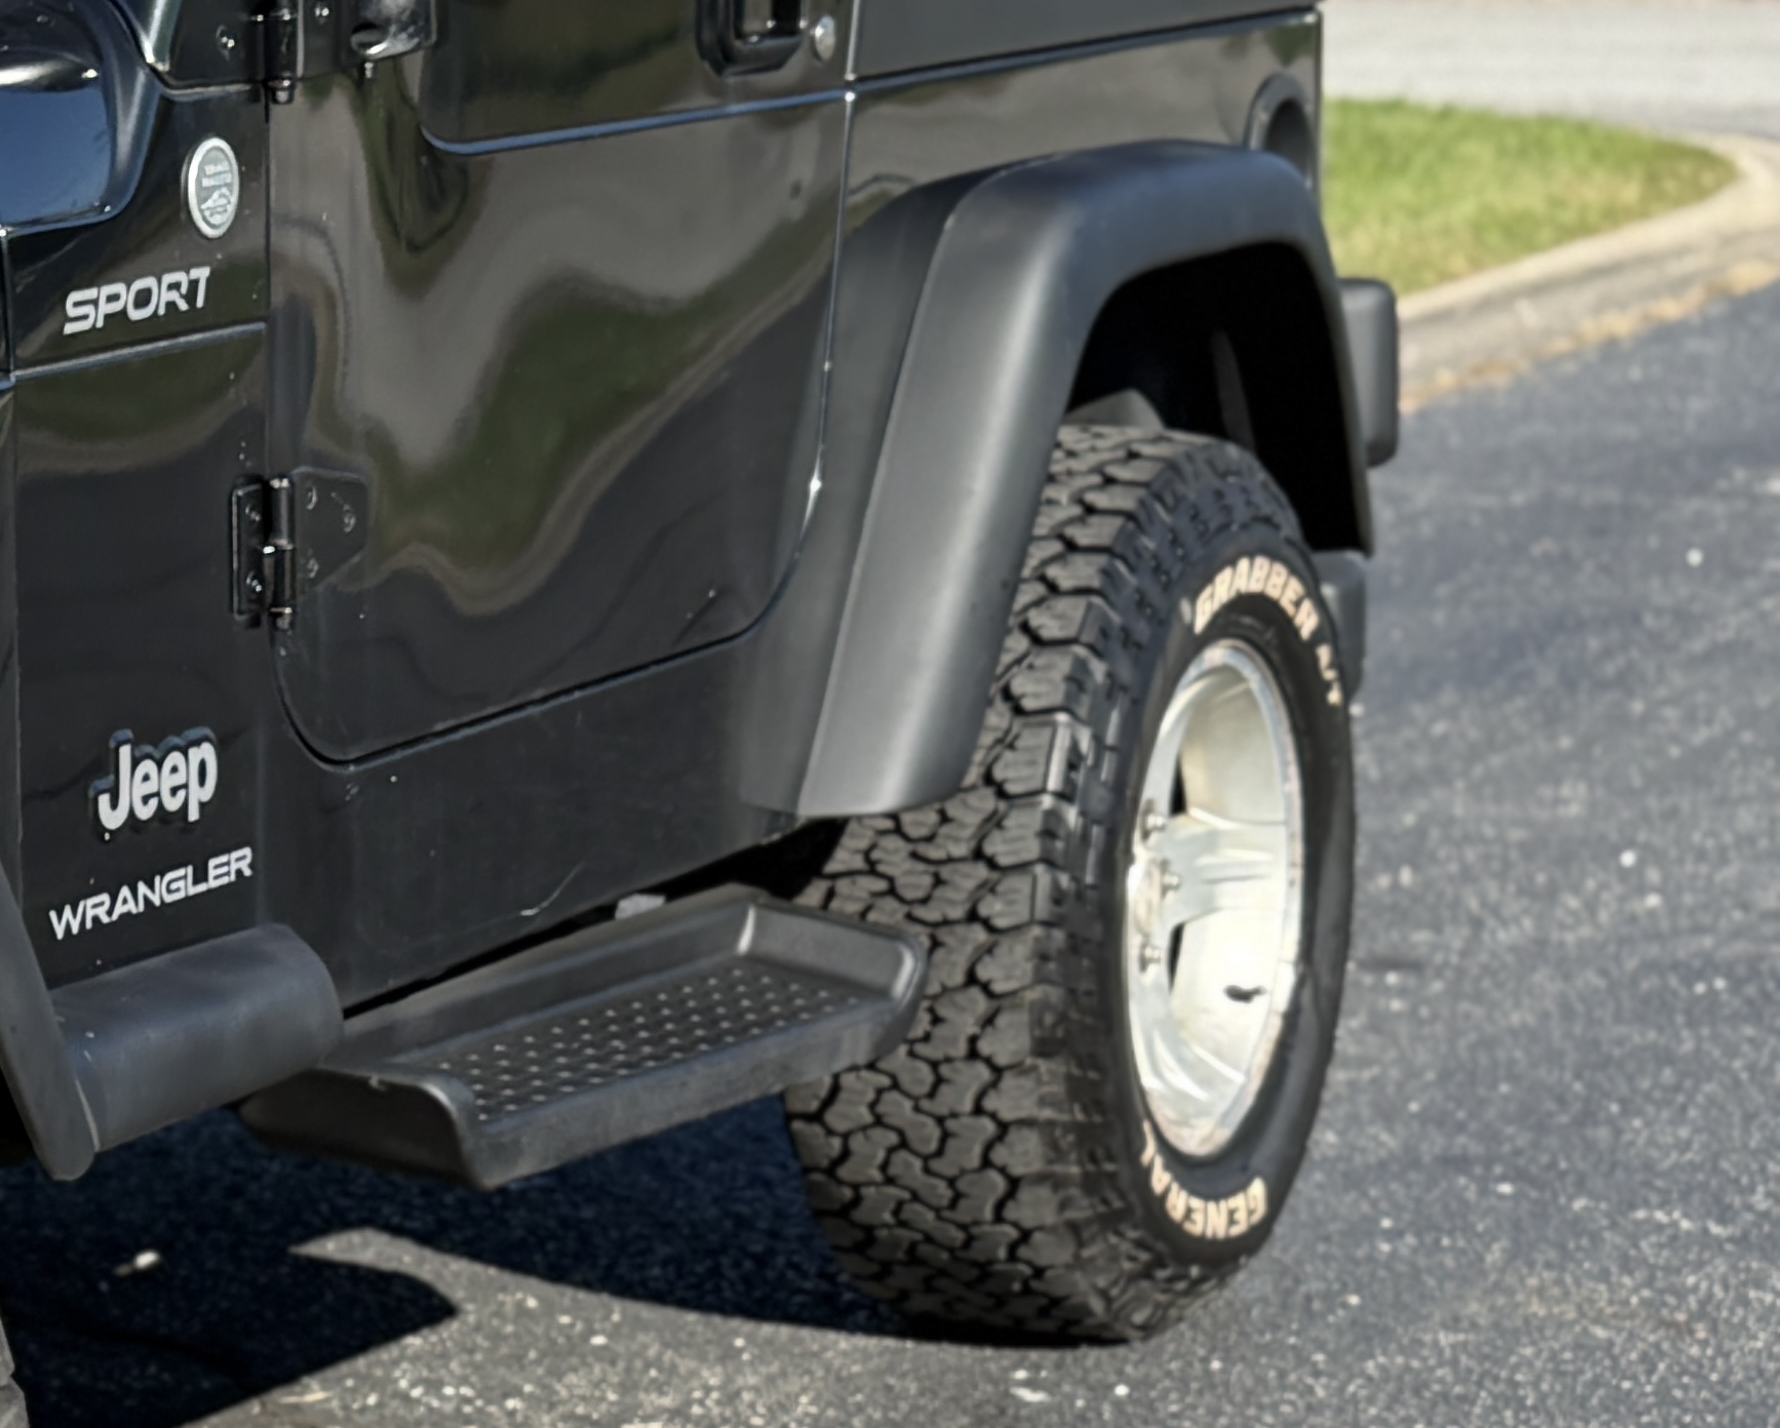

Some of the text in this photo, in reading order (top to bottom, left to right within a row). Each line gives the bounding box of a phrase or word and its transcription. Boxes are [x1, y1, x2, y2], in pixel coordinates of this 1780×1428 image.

[63, 266, 211, 335] SPORT
[1193, 555, 1320, 642] GRABBER
[96, 740, 218, 831] Jeep
[49, 846, 253, 941] WRANGLER
[1140, 1118, 1268, 1240] GENERAL
